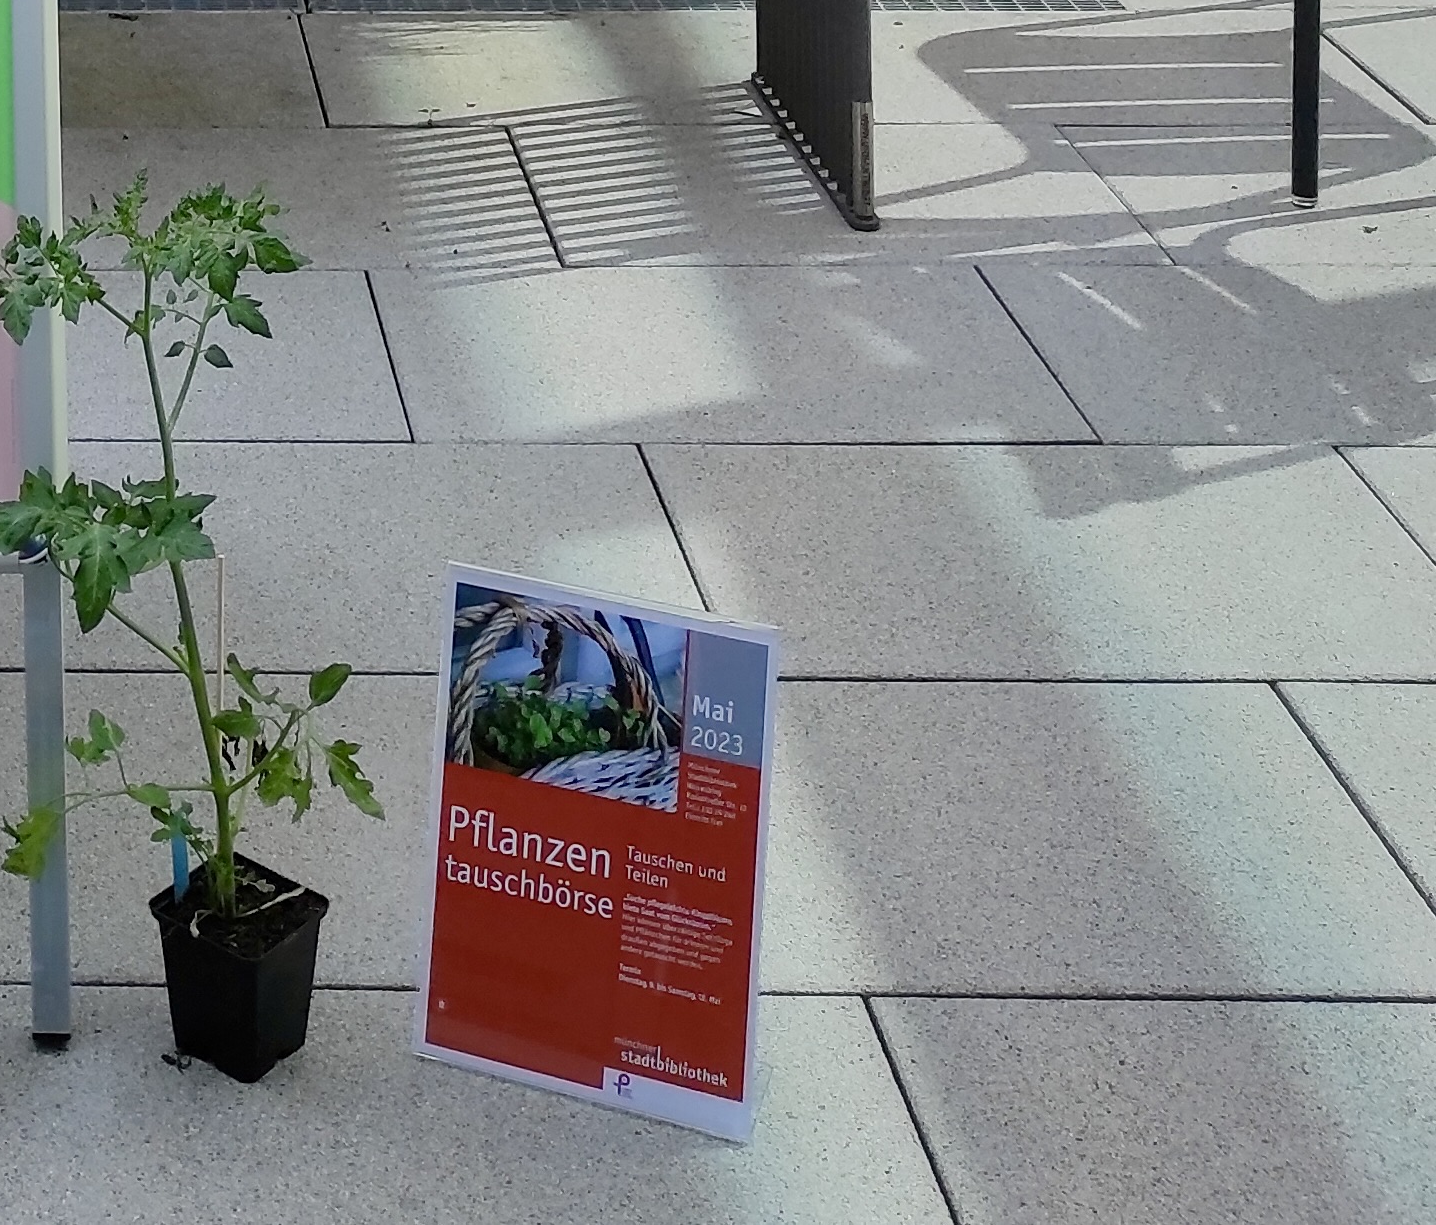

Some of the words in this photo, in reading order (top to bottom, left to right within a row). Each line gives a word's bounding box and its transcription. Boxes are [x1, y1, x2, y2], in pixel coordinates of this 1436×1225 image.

[692, 695, 734, 723] Mai
[691, 726, 743, 756] 2023
[449, 805, 610, 878] Pflanzen
[625, 865, 668, 888] Teilen
[626, 845, 694, 874] Tauschen
[698, 865, 726, 882] und
[445, 854, 613, 918] tauschbörse
[620, 1045, 728, 1088] stadtbibliothek
